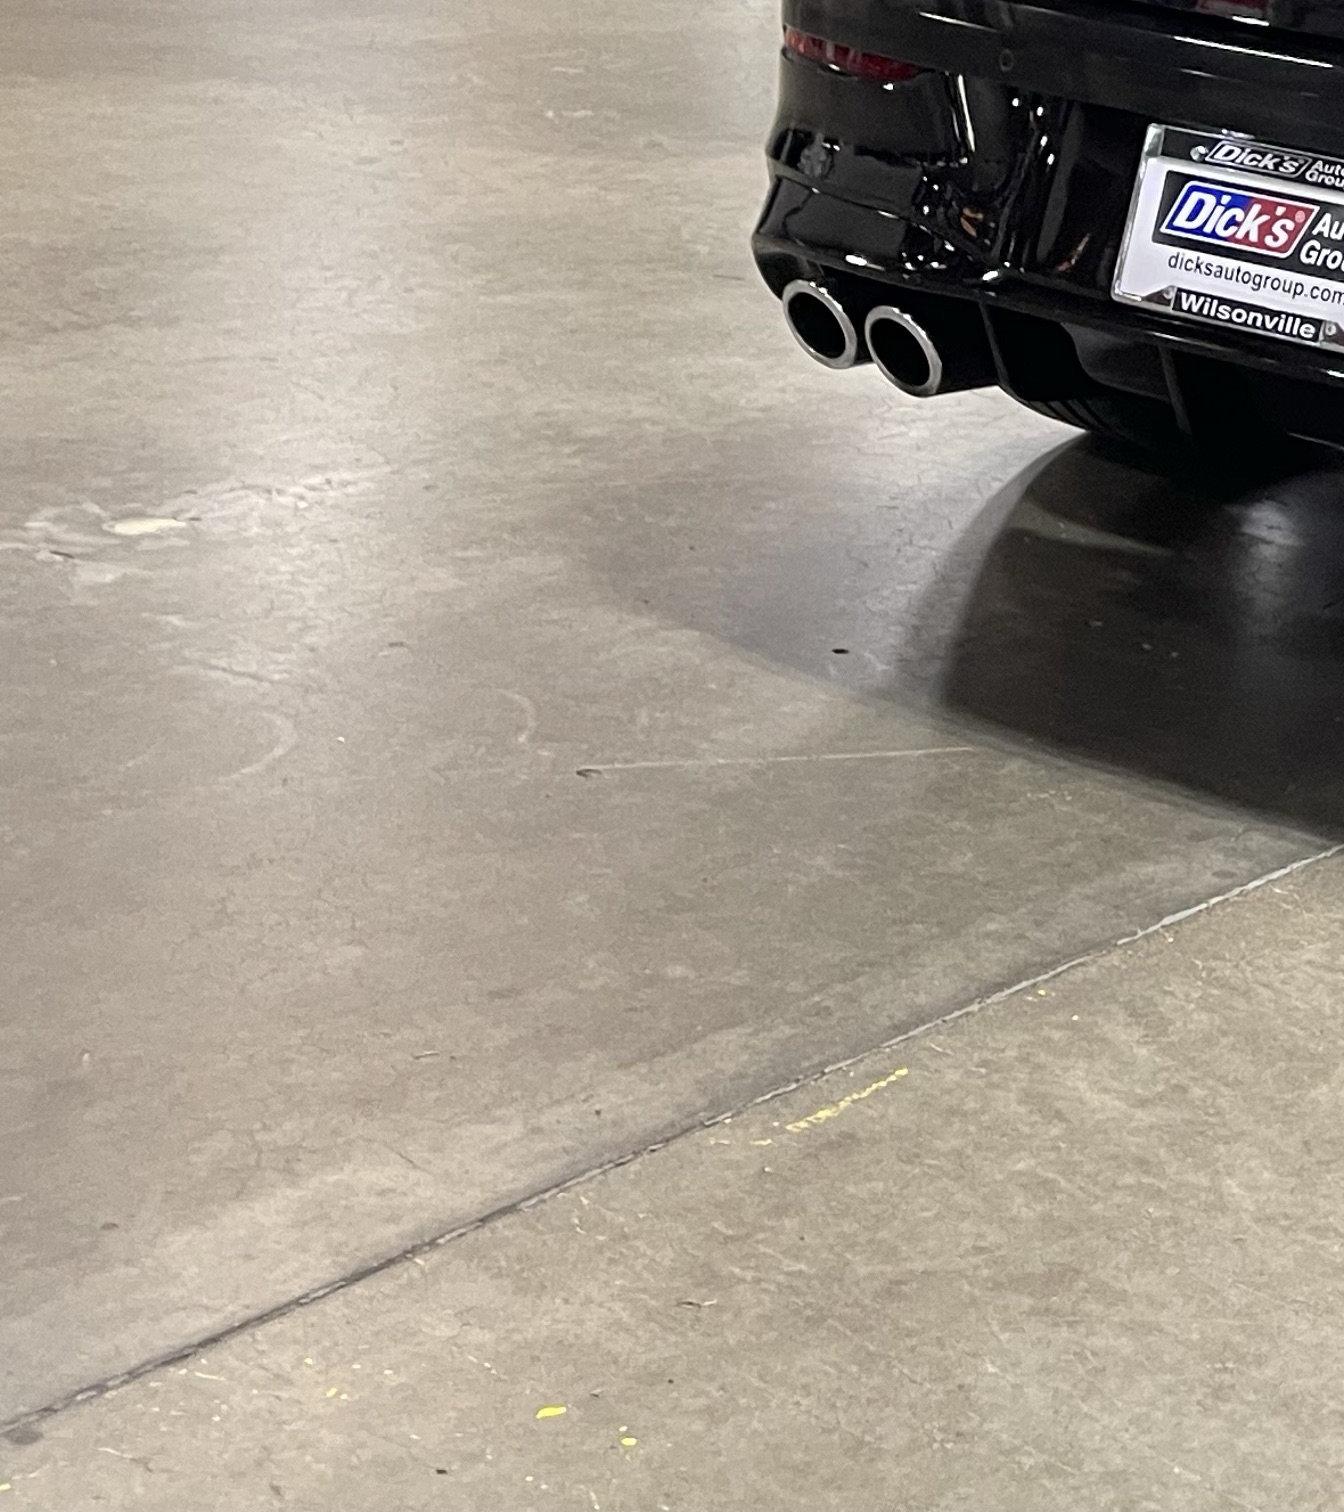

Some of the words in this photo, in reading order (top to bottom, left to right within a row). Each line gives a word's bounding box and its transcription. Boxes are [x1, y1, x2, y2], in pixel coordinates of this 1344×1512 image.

[1213, 143, 1300, 174] Dick's
[1172, 190, 1296, 248] Dick's
[1179, 290, 1316, 339] Wilsonville
